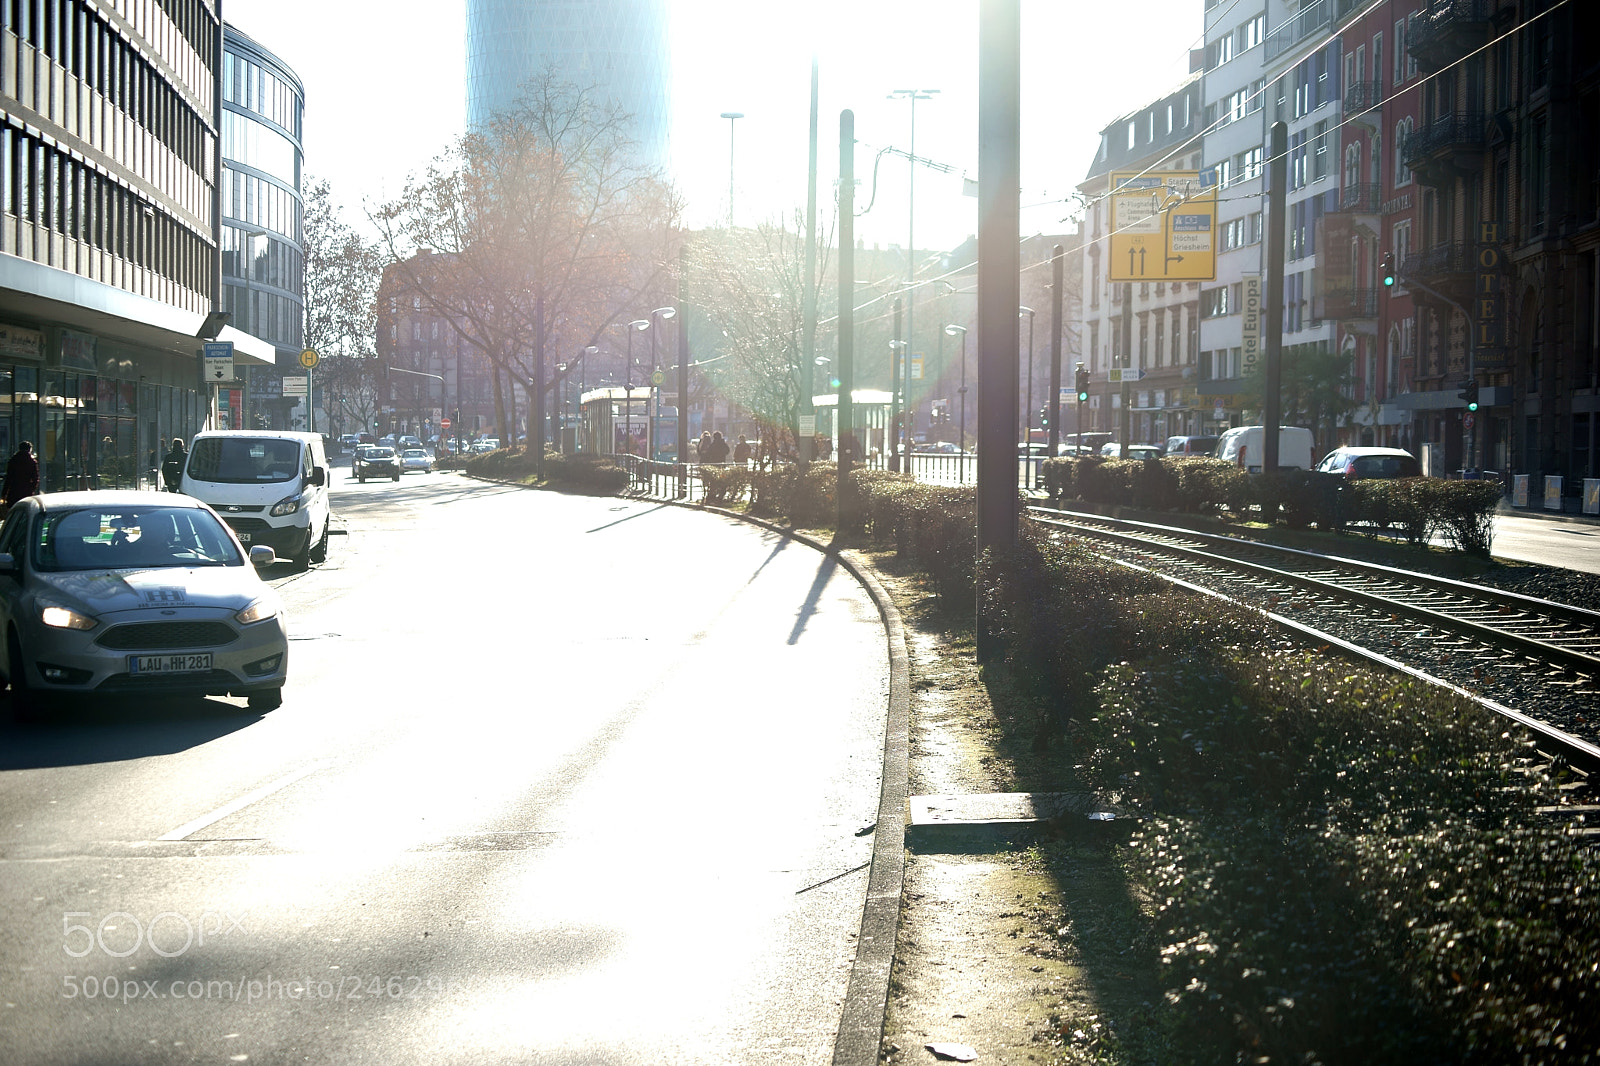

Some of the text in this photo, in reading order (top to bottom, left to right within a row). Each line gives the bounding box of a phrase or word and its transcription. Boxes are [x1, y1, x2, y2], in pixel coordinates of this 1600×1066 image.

[1480, 223, 1498, 345] HOTEL
[1242, 279, 1260, 374] Hotel Europa
[304, 353, 314, 364] H
[1204, 395, 1233, 406] Hel
[138, 655, 211, 672] LAU HH 281
